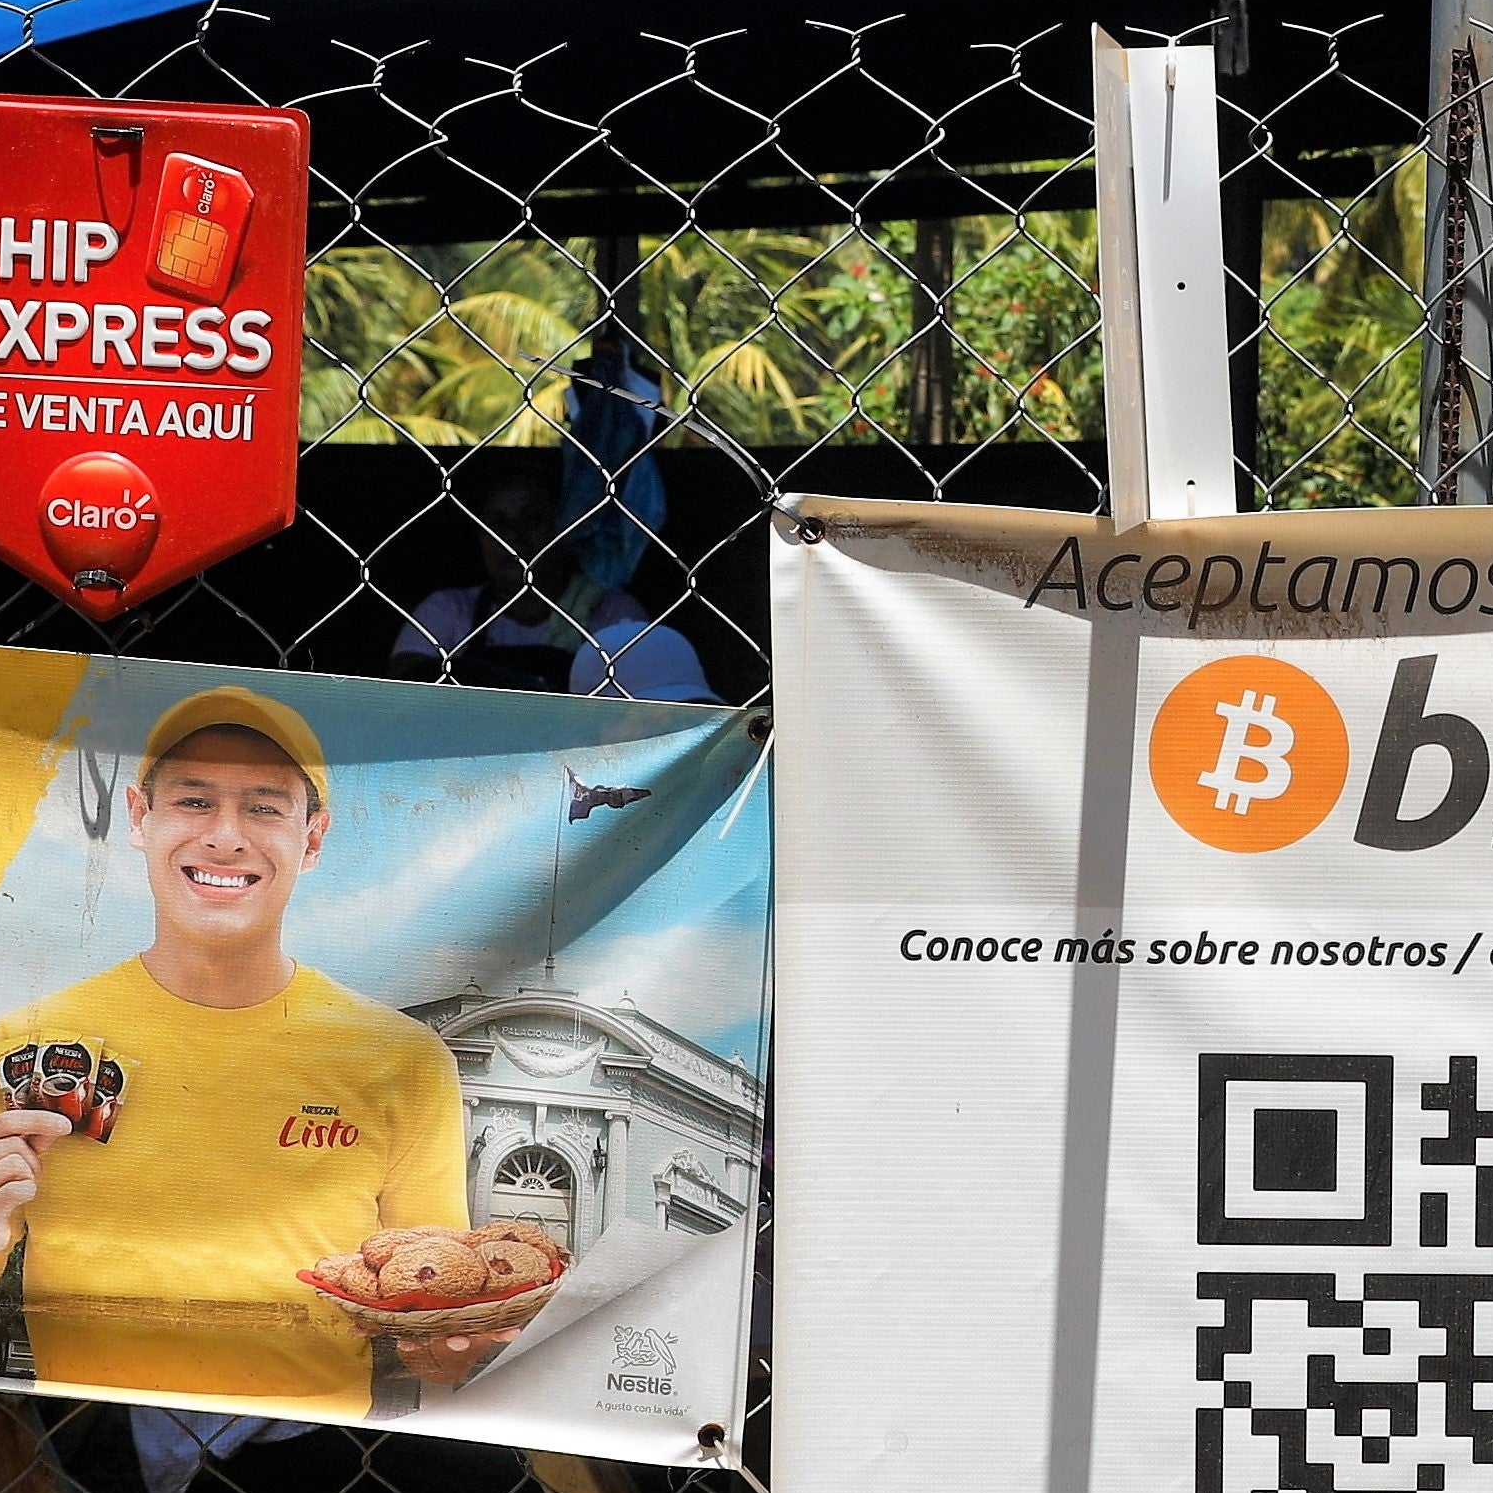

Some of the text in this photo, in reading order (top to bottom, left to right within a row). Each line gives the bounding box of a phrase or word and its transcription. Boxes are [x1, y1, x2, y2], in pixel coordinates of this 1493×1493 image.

[197, 173, 216, 214] Claro
[13, 393, 150, 437] VENTA
[155, 393, 256, 441] AQUÍ
[47, 489, 156, 530] Claro
[899, 929, 1043, 965] Conoce
[1053, 927, 1136, 966] más
[1147, 931, 1256, 968] sobre
[1270, 934, 1448, 968] nosotros
[279, 1115, 359, 1149] Listo
[607, 1373, 672, 1396] Nestlé
[604, 1402, 632, 1412] gusto
[634, 1405, 651, 1413] con
[653, 1405, 662, 1414] la
